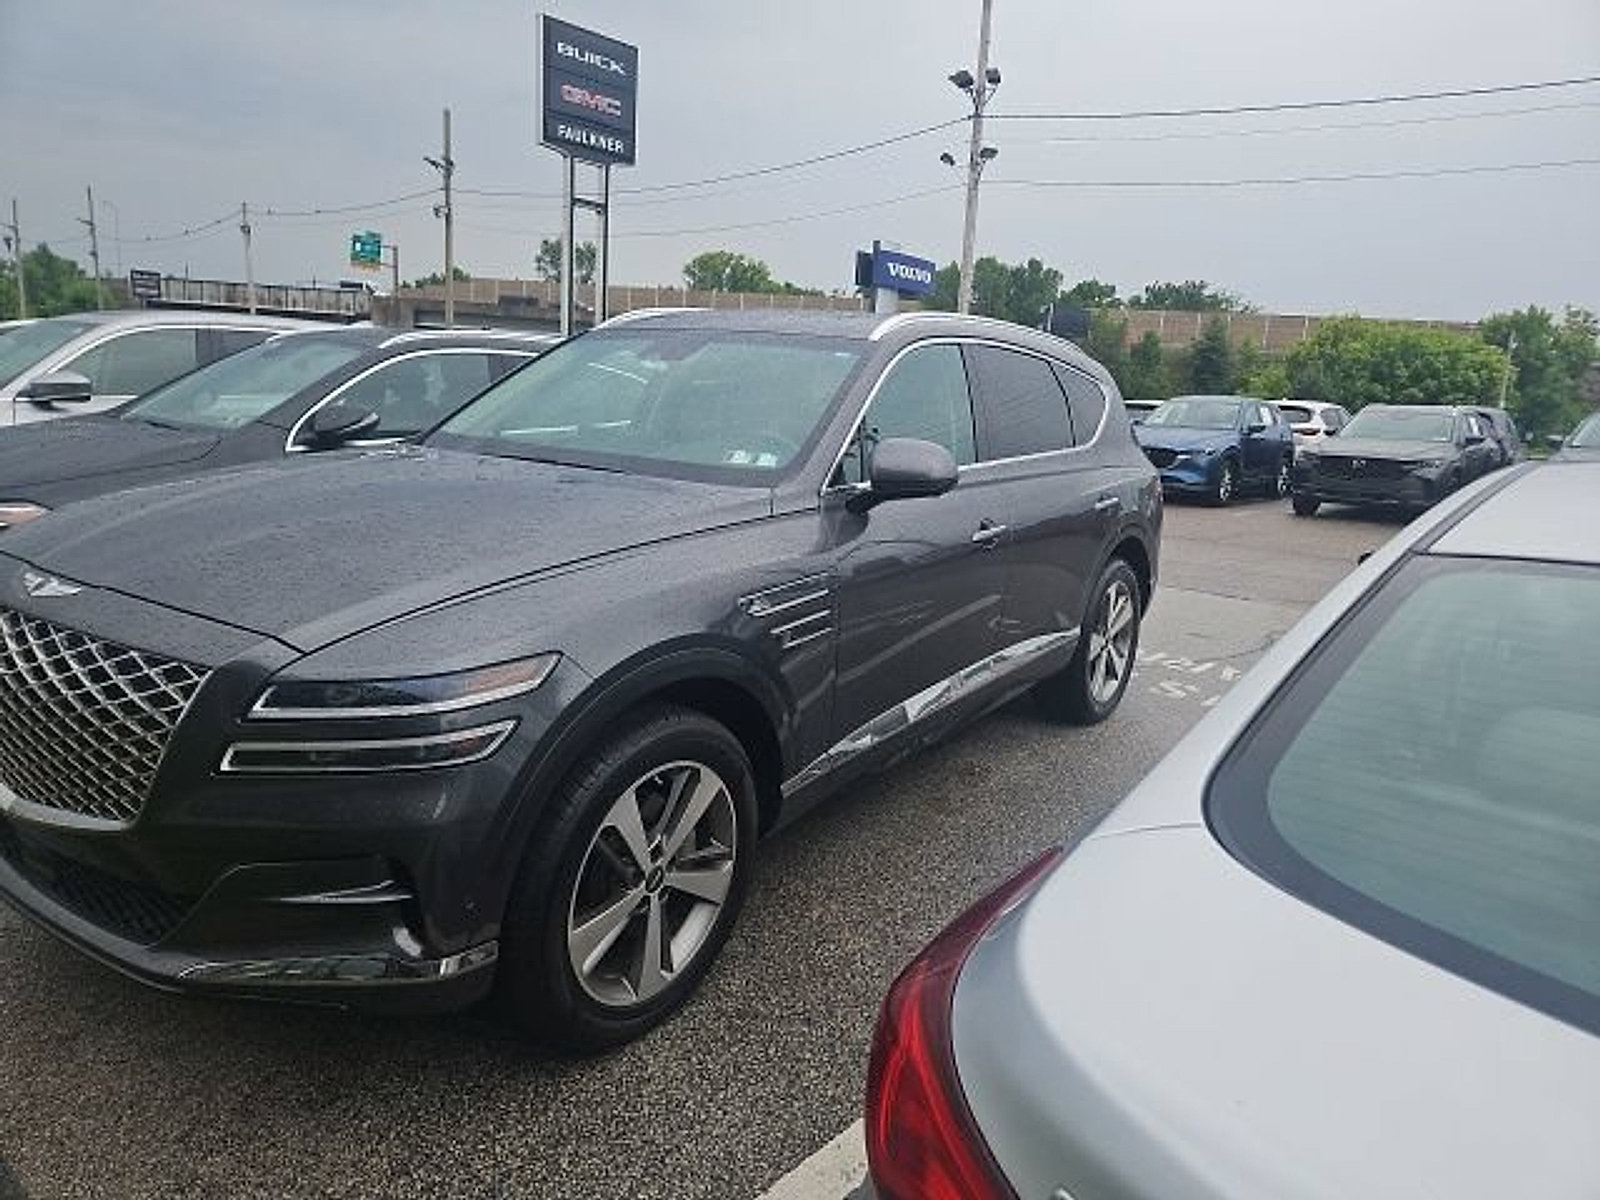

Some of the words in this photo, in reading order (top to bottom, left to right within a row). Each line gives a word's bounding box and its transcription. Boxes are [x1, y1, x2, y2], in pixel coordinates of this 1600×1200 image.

[557, 41, 626, 75] BUICK
[560, 84, 621, 116] GMC
[557, 124, 624, 153] FAULKNER
[887, 262, 931, 284] VOLVO
